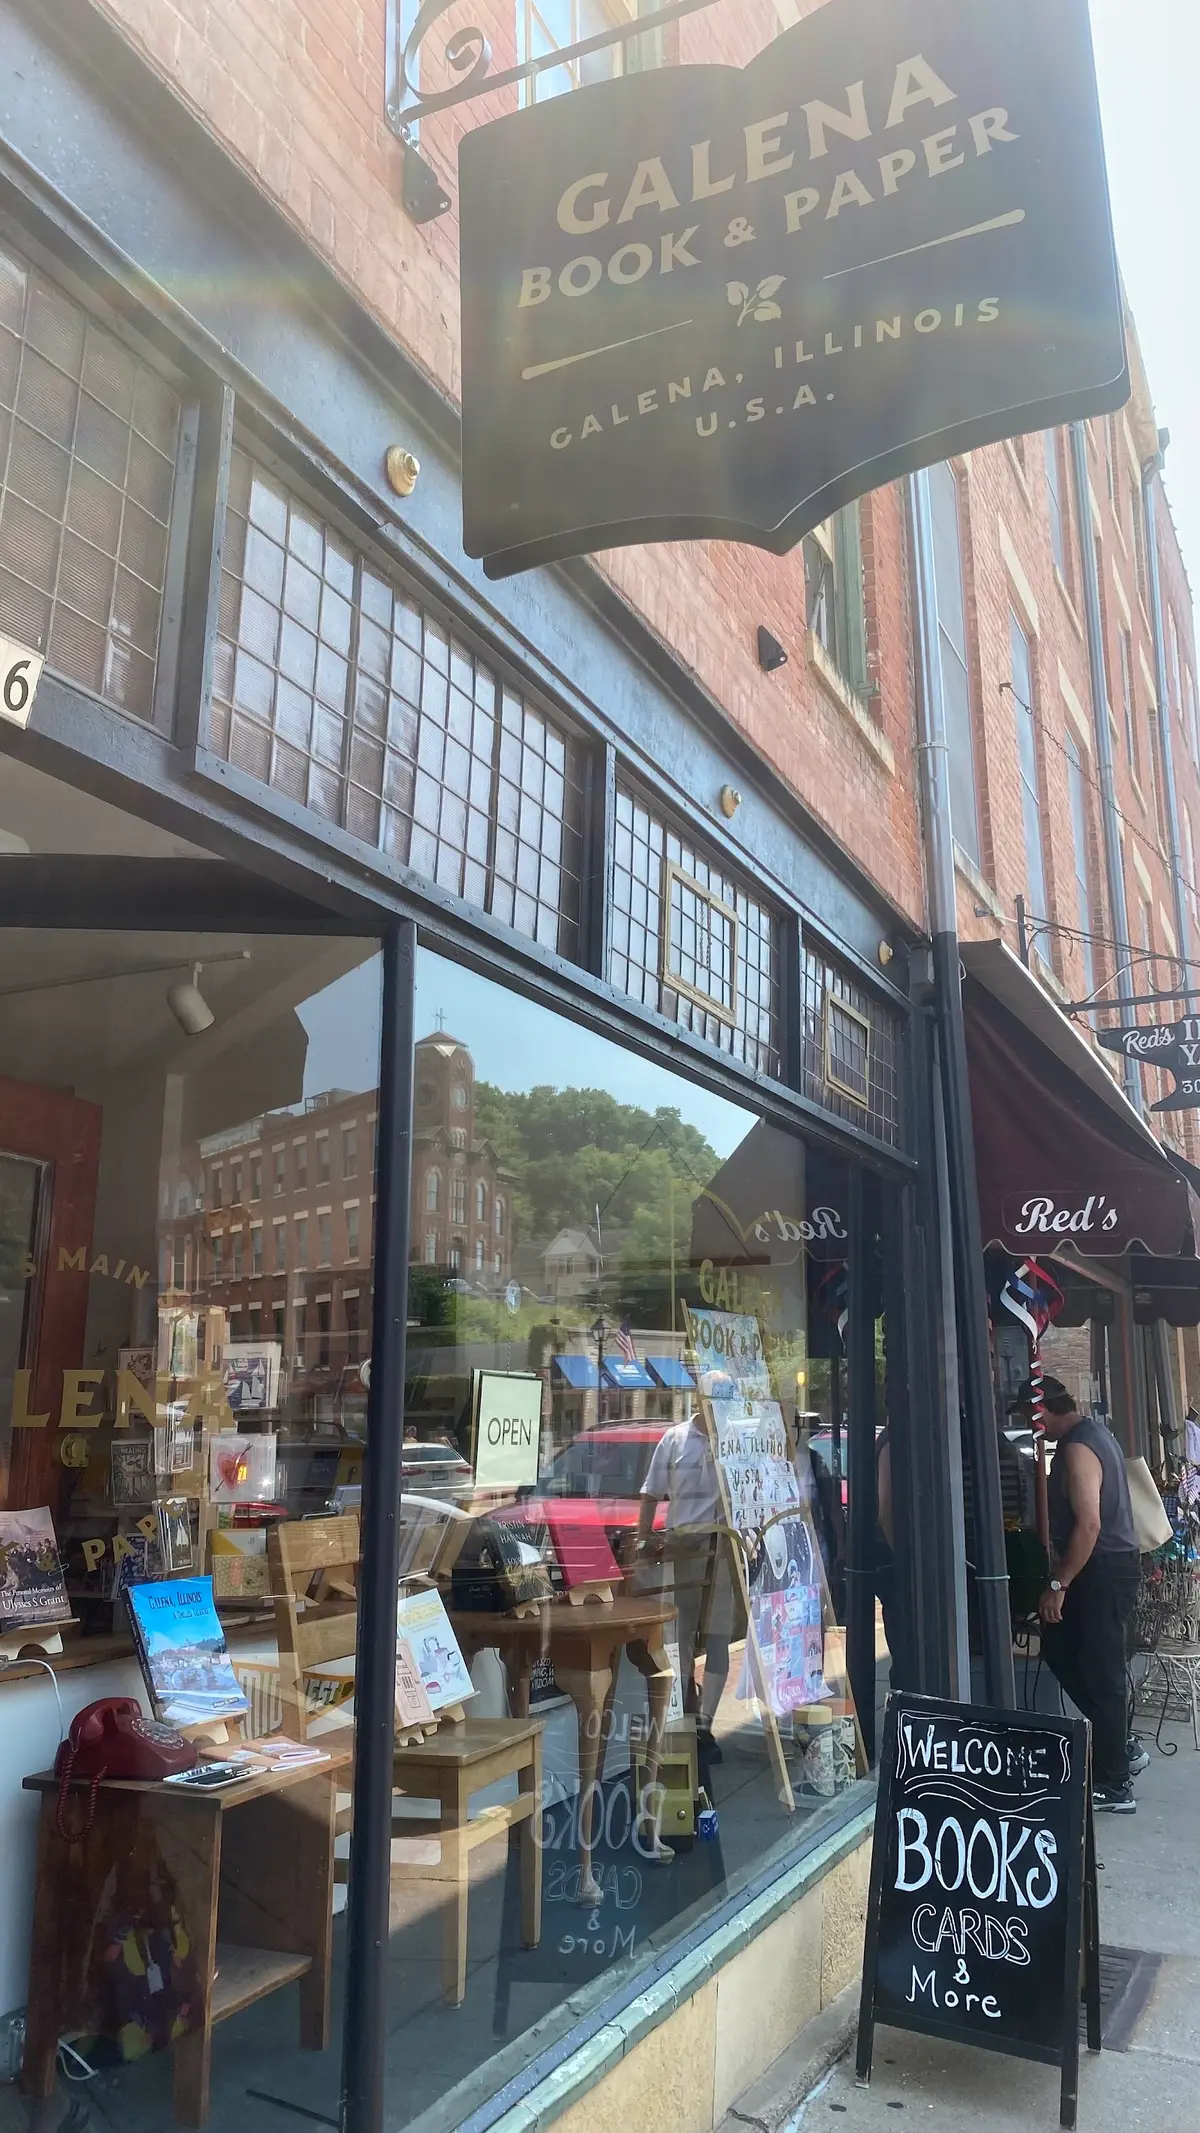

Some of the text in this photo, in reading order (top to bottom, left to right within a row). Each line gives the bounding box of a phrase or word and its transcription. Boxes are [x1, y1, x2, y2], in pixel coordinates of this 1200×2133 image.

[556, 54, 959, 235] GALENA
[517, 108, 1020, 308] BOOK & PAPER
[550, 298, 1001, 450] GALENA, ILLINOIS
[695, 384, 836, 438] U.S.A.
[3, 660, 31, 711] 6
[1121, 1026, 1175, 1055] Red's
[1015, 1195, 1118, 1233] Red's
[58, 1246, 151, 1290] MAIN
[689, 1312, 735, 1358] BOOK
[487, 1417, 531, 1446] OPEN
[500, 1532, 532, 1544] HANNAH
[40, 1595, 65, 1606] Grant
[904, 1724, 1049, 1788] WELCOME
[894, 1808, 1059, 1908] BOOKS
[911, 1903, 1031, 1966] CARDS
[906, 1964, 1002, 2018] More
[953, 1958, 971, 1984] &
